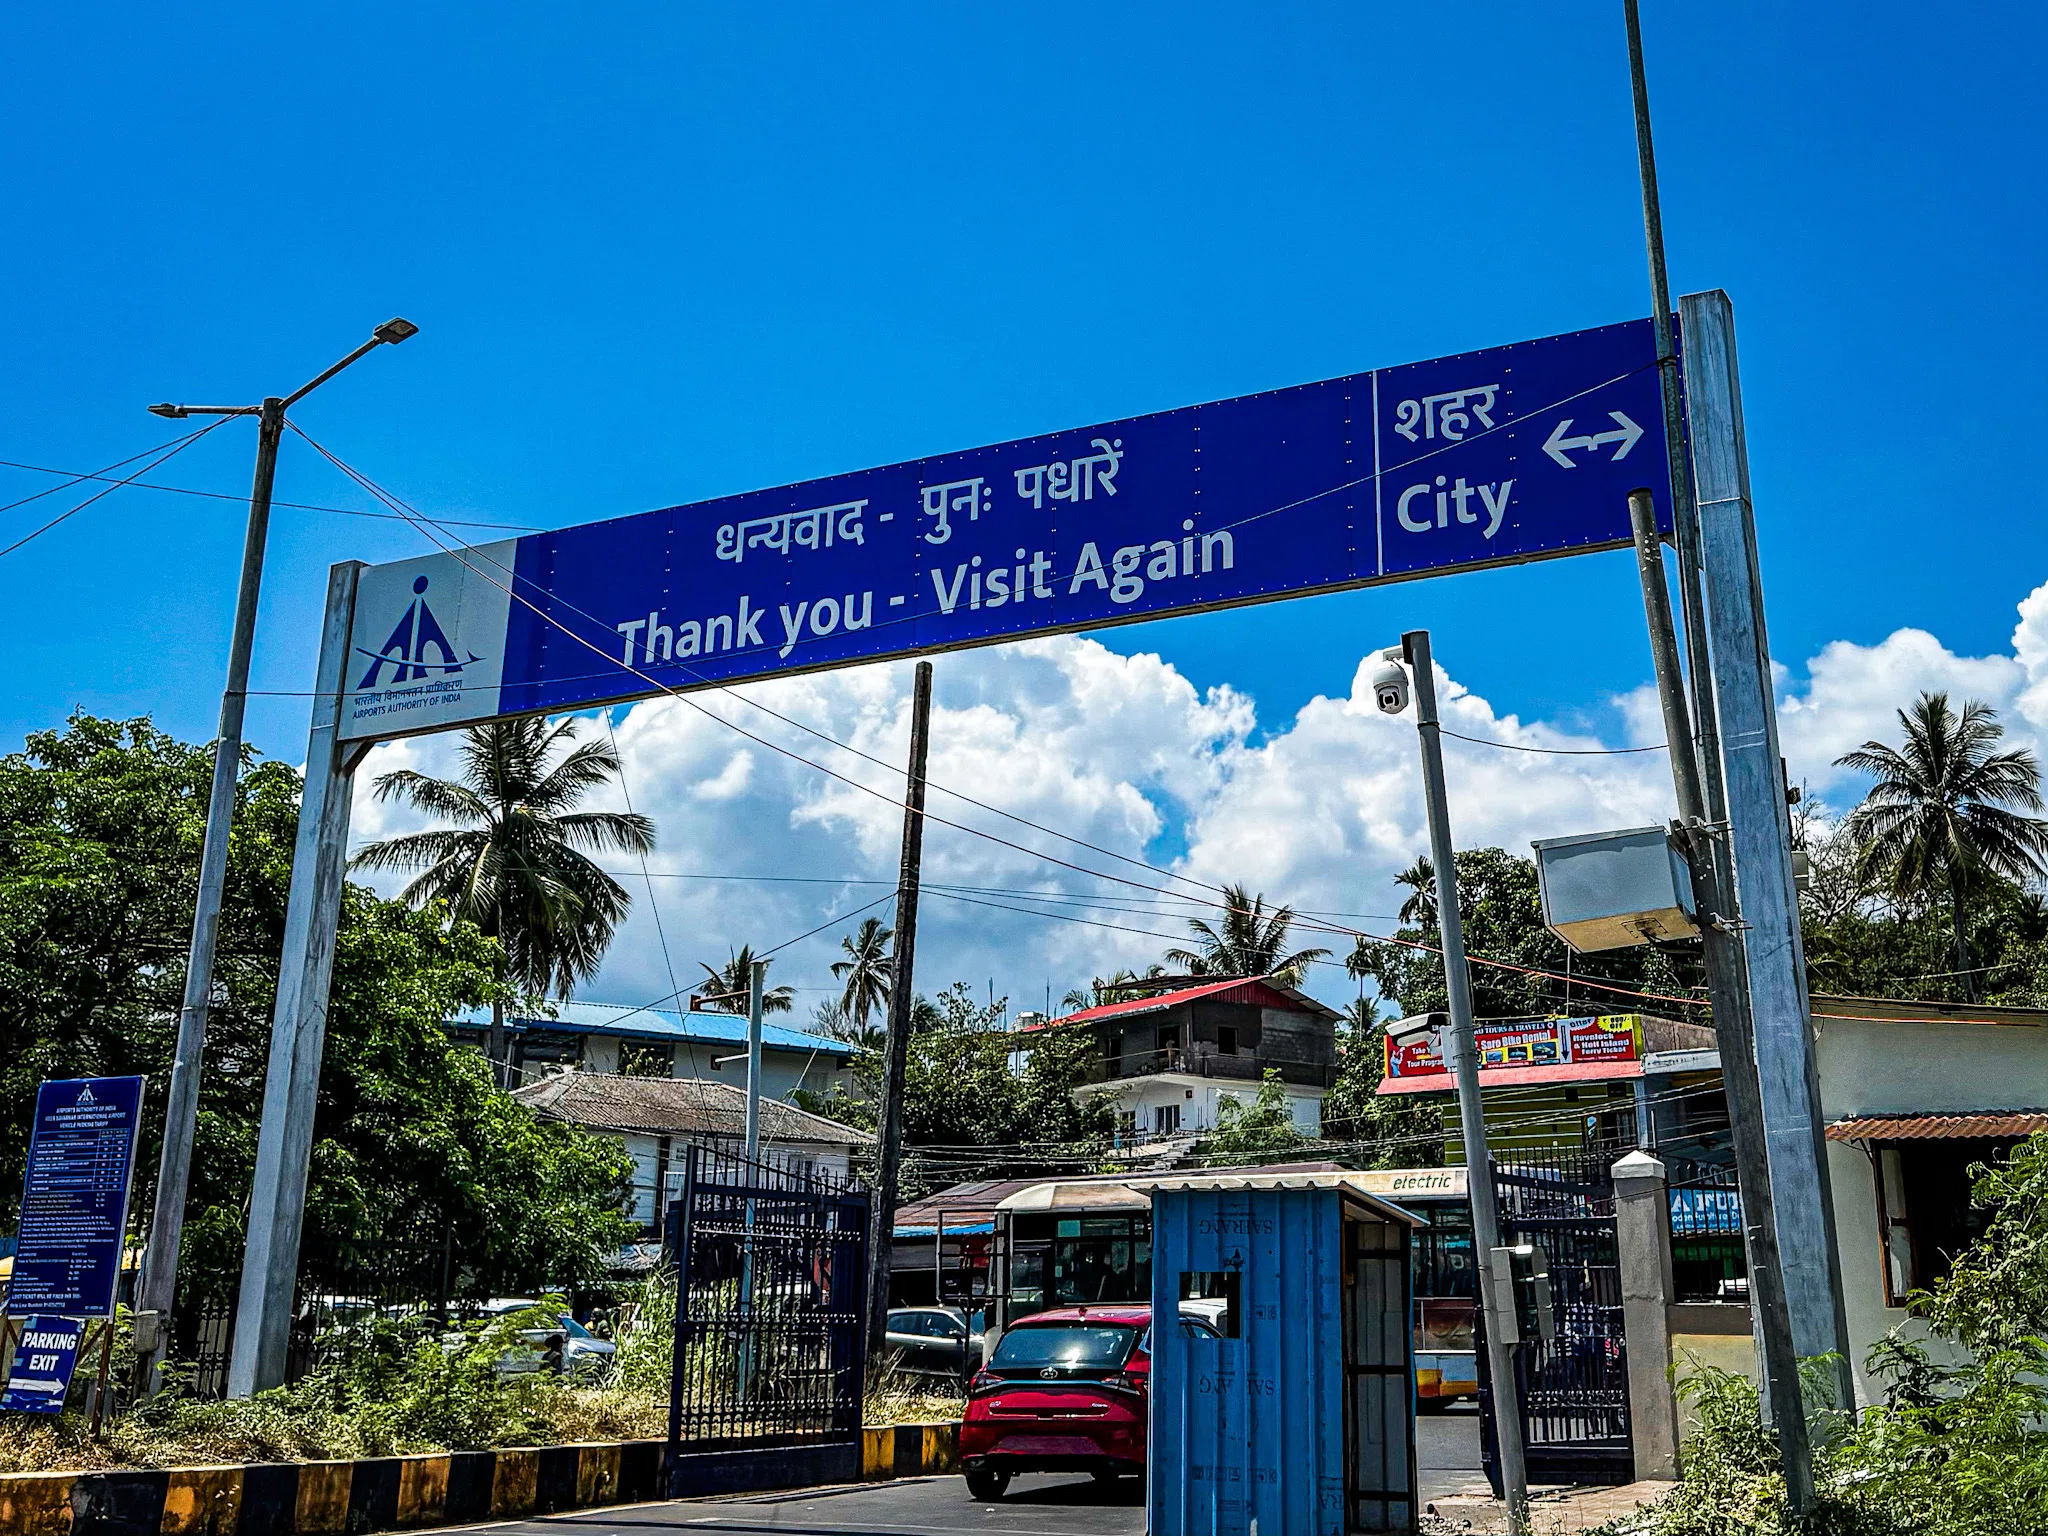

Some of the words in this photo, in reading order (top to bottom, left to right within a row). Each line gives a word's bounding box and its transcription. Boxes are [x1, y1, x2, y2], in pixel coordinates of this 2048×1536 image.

[1395, 383, 1500, 442] शहर
[715, 498, 869, 564] धन्यवाद
[921, 476, 992, 544] पुनः
[1014, 438, 1123, 509] पधारें
[1397, 475, 1513, 540] City
[617, 596, 765, 667] Thank
[779, 590, 872, 659] you
[931, 547, 1053, 615] Visit
[1069, 519, 1234, 604] Again
[352, 705, 386, 720] AIRPORTS
[387, 697, 429, 714] AUTHORITY
[429, 696, 440, 706] OF
[441, 693, 461, 704] INDIA
[1393, 1172, 1452, 1190] electric
[21, 1332, 77, 1350] PARKING
[28, 1354, 60, 1371] EXIT
